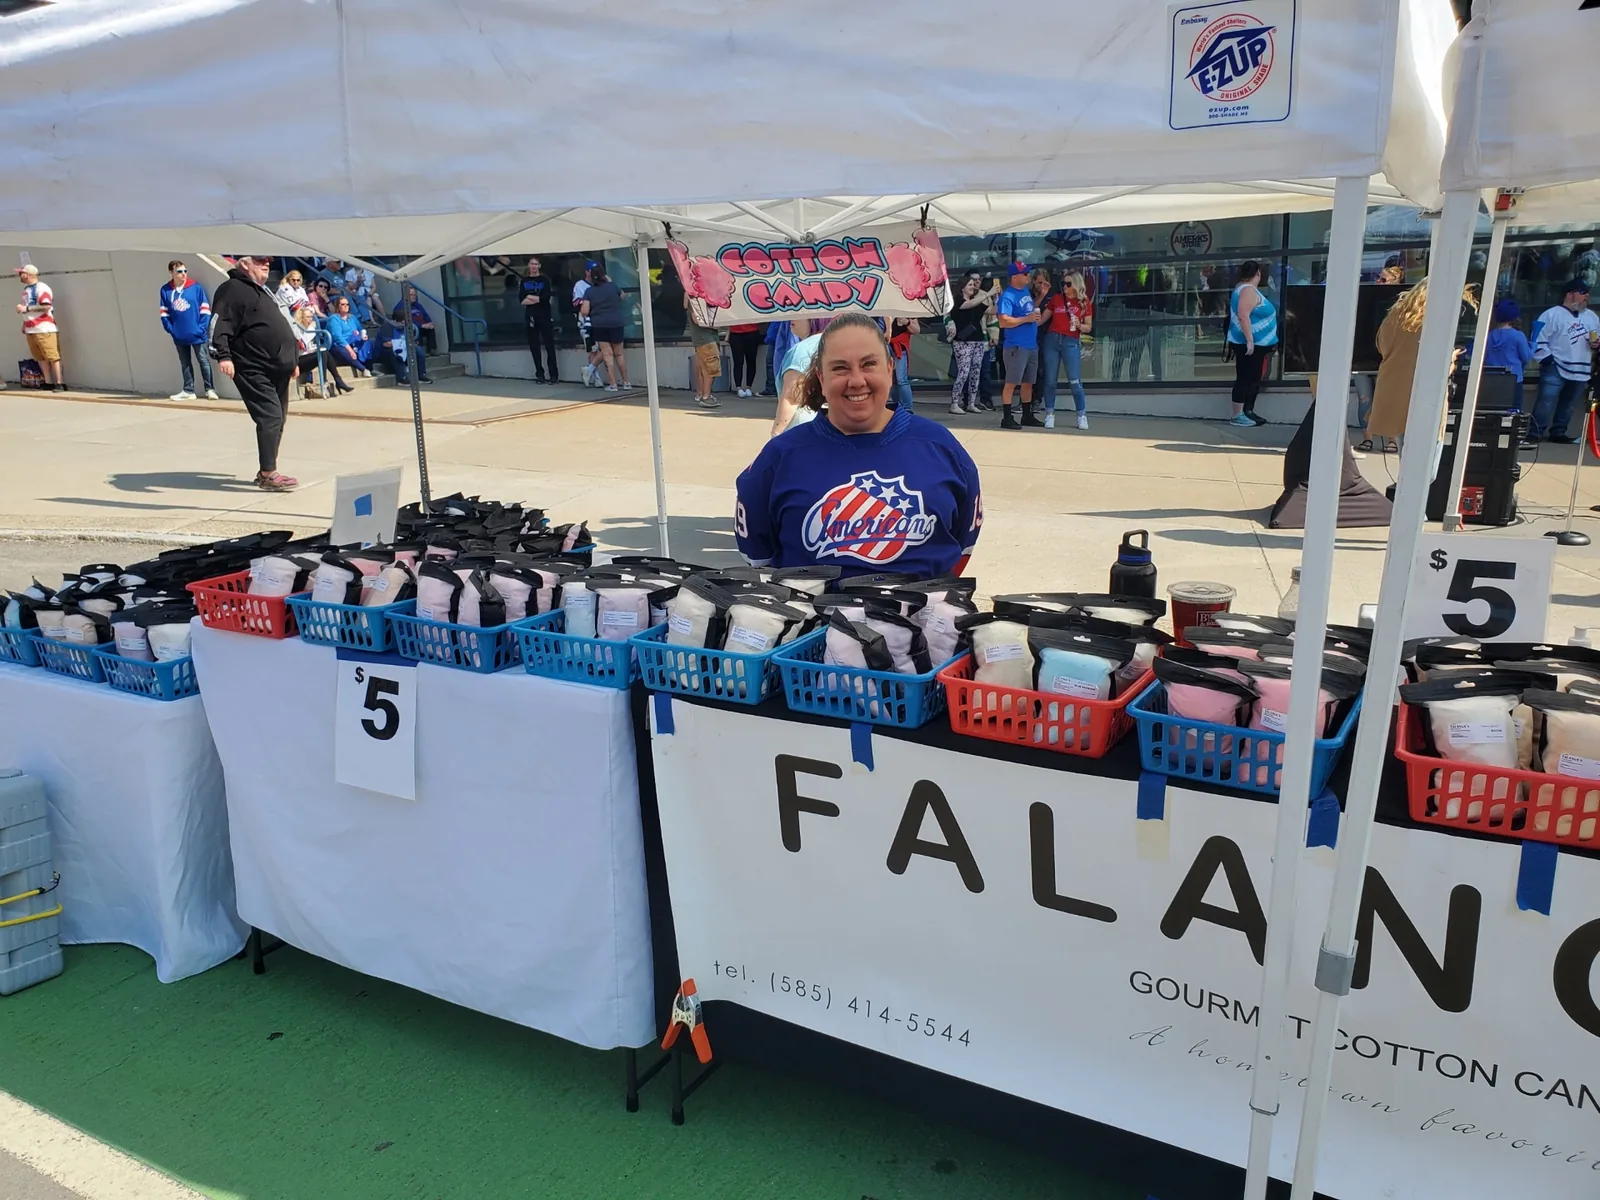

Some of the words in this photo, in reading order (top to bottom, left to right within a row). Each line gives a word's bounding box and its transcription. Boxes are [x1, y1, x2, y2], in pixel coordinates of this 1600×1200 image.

[1181, 17, 1208, 26] Embassy
[1208, 20, 1226, 36] Fastest
[1226, 18, 1247, 26] Shelters
[1220, 86, 1253, 100] ORIGINAL
[1252, 63, 1269, 86] SHADE
[1208, 105, 1249, 114] ezup.com
[717, 239, 888, 276] COTTON
[744, 275, 882, 312] CANDY
[804, 500, 935, 547] Americans
[713, 960, 756, 983] tel.
[770, 972, 831, 1009] (585)
[848, 996, 970, 1047] 414-5544
[1129, 971, 1311, 1039] GOURMT
